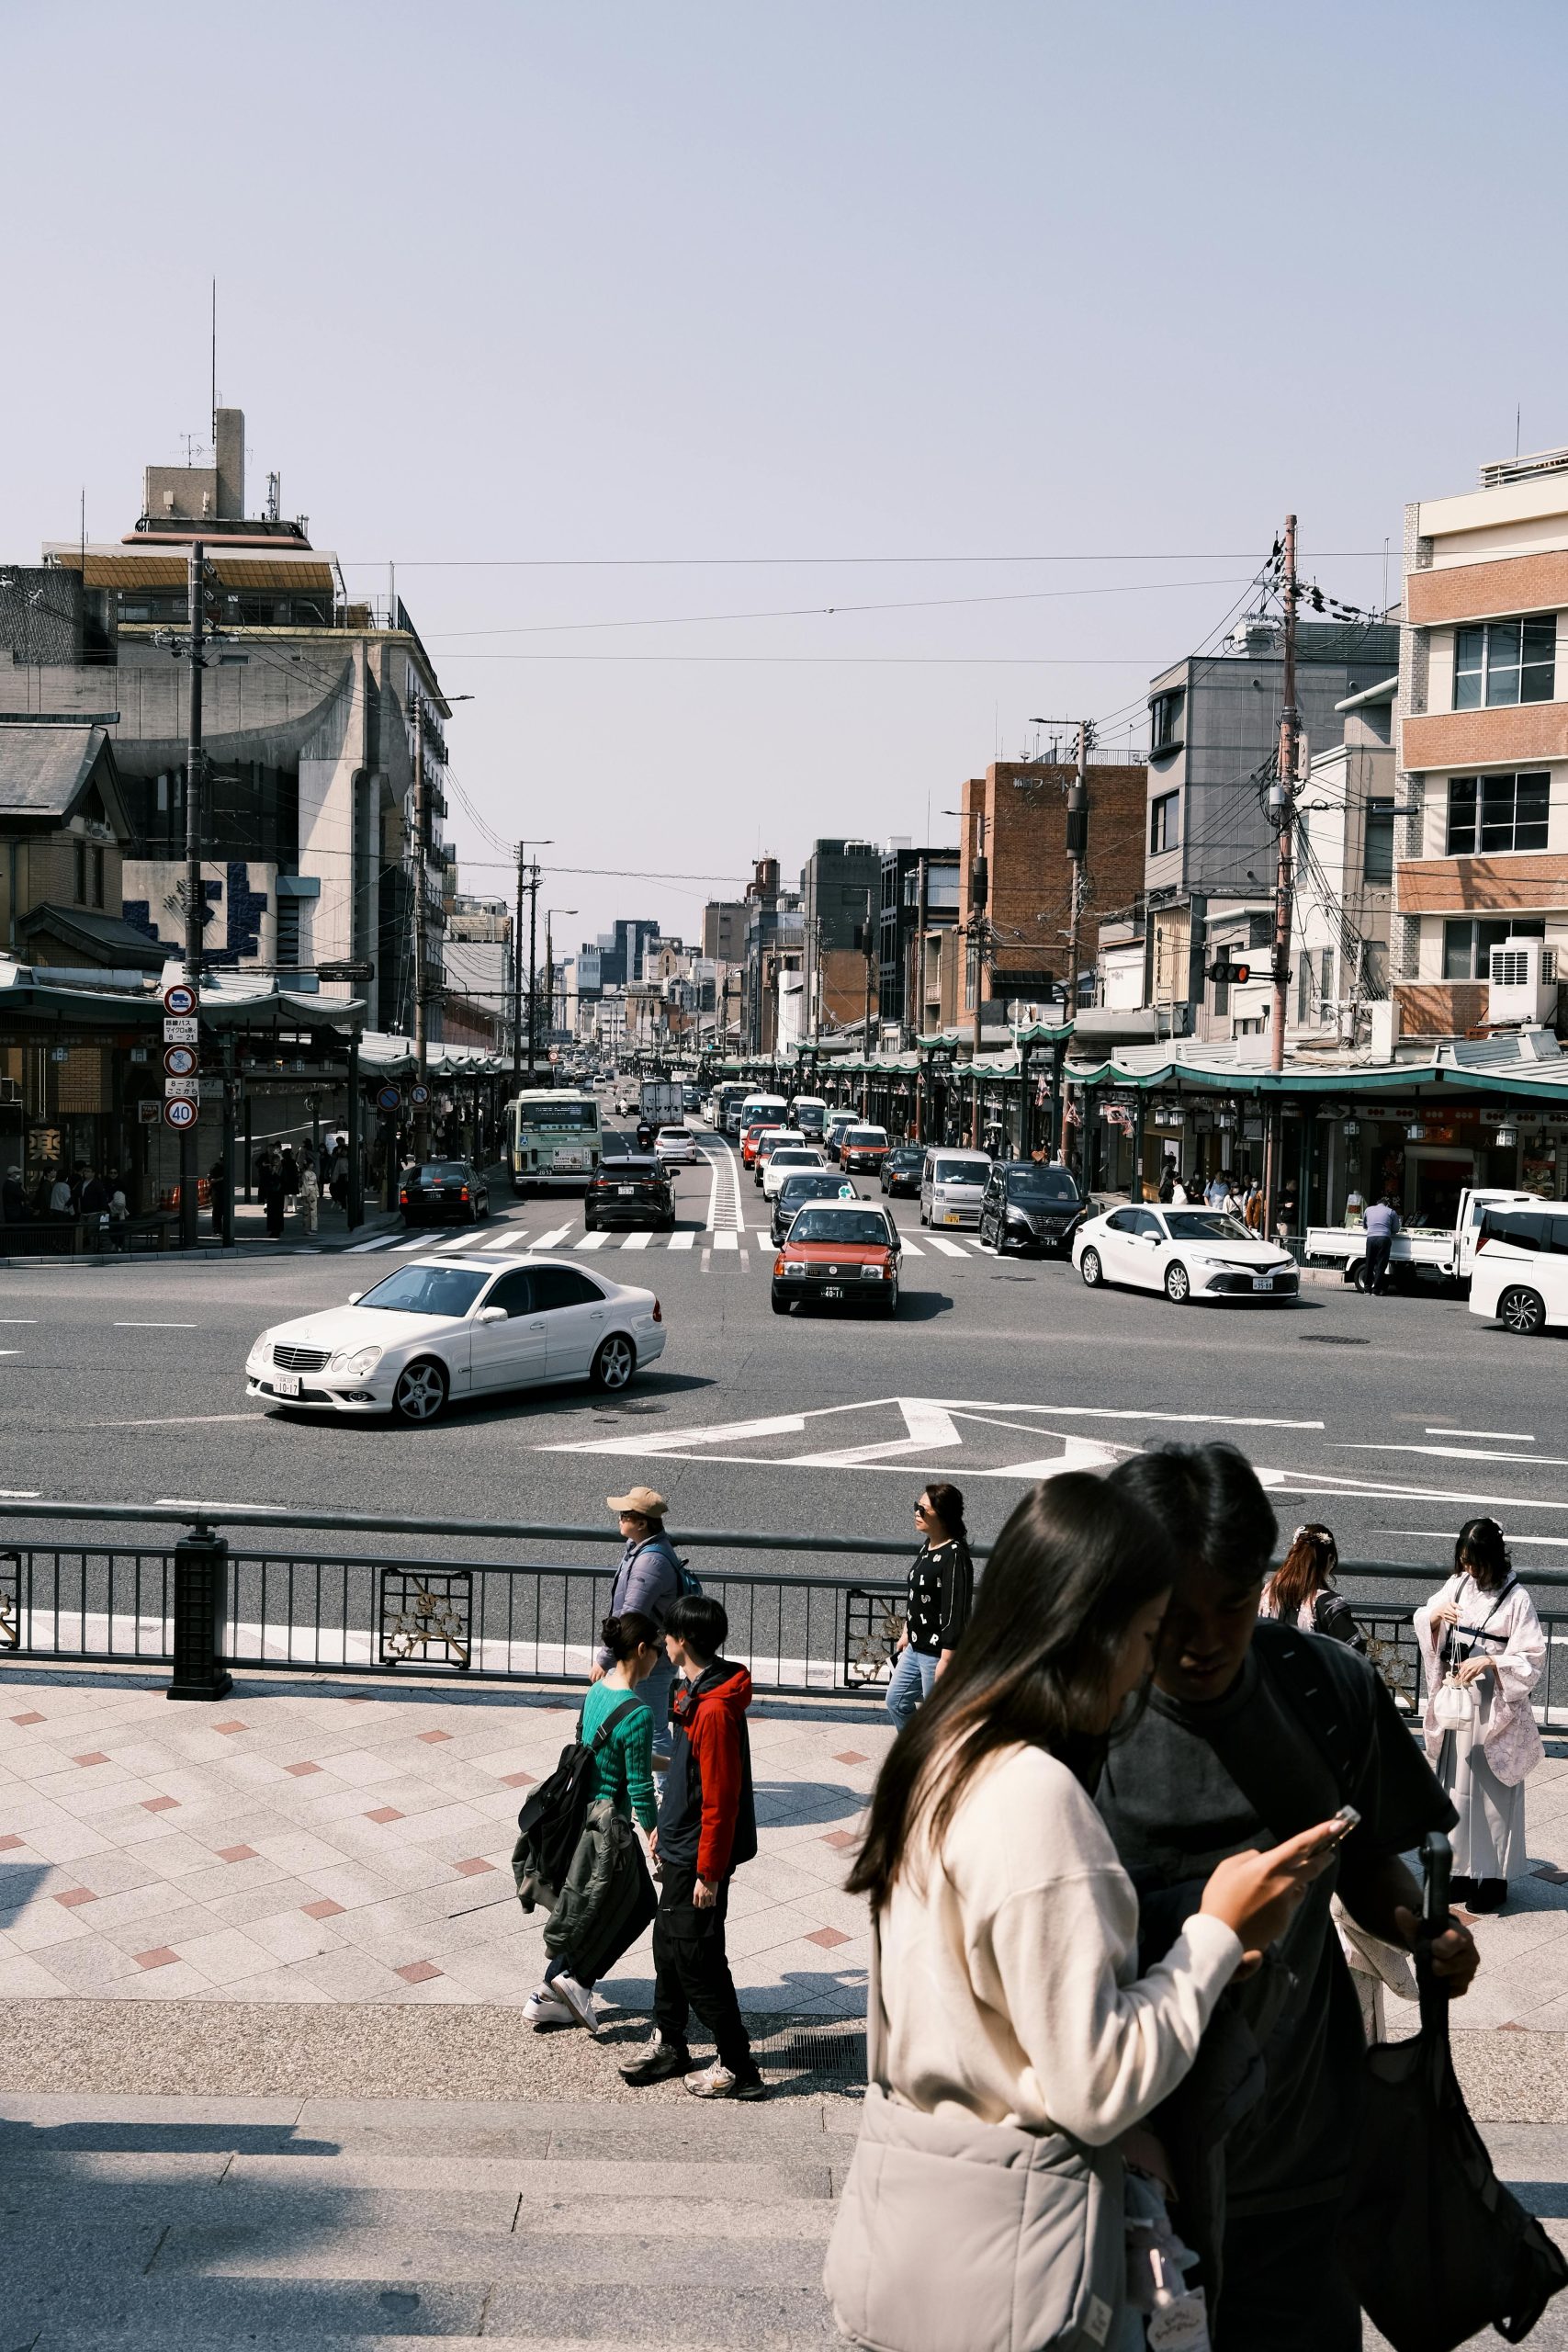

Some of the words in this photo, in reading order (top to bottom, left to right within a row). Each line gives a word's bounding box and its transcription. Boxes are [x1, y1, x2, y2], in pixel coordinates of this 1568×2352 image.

[172, 1106, 190, 1121] 40
[28, 1128, 61, 1160] 薬
[280, 1383, 297, 1394] 10-17
[929, 1633, 939, 1646] R
